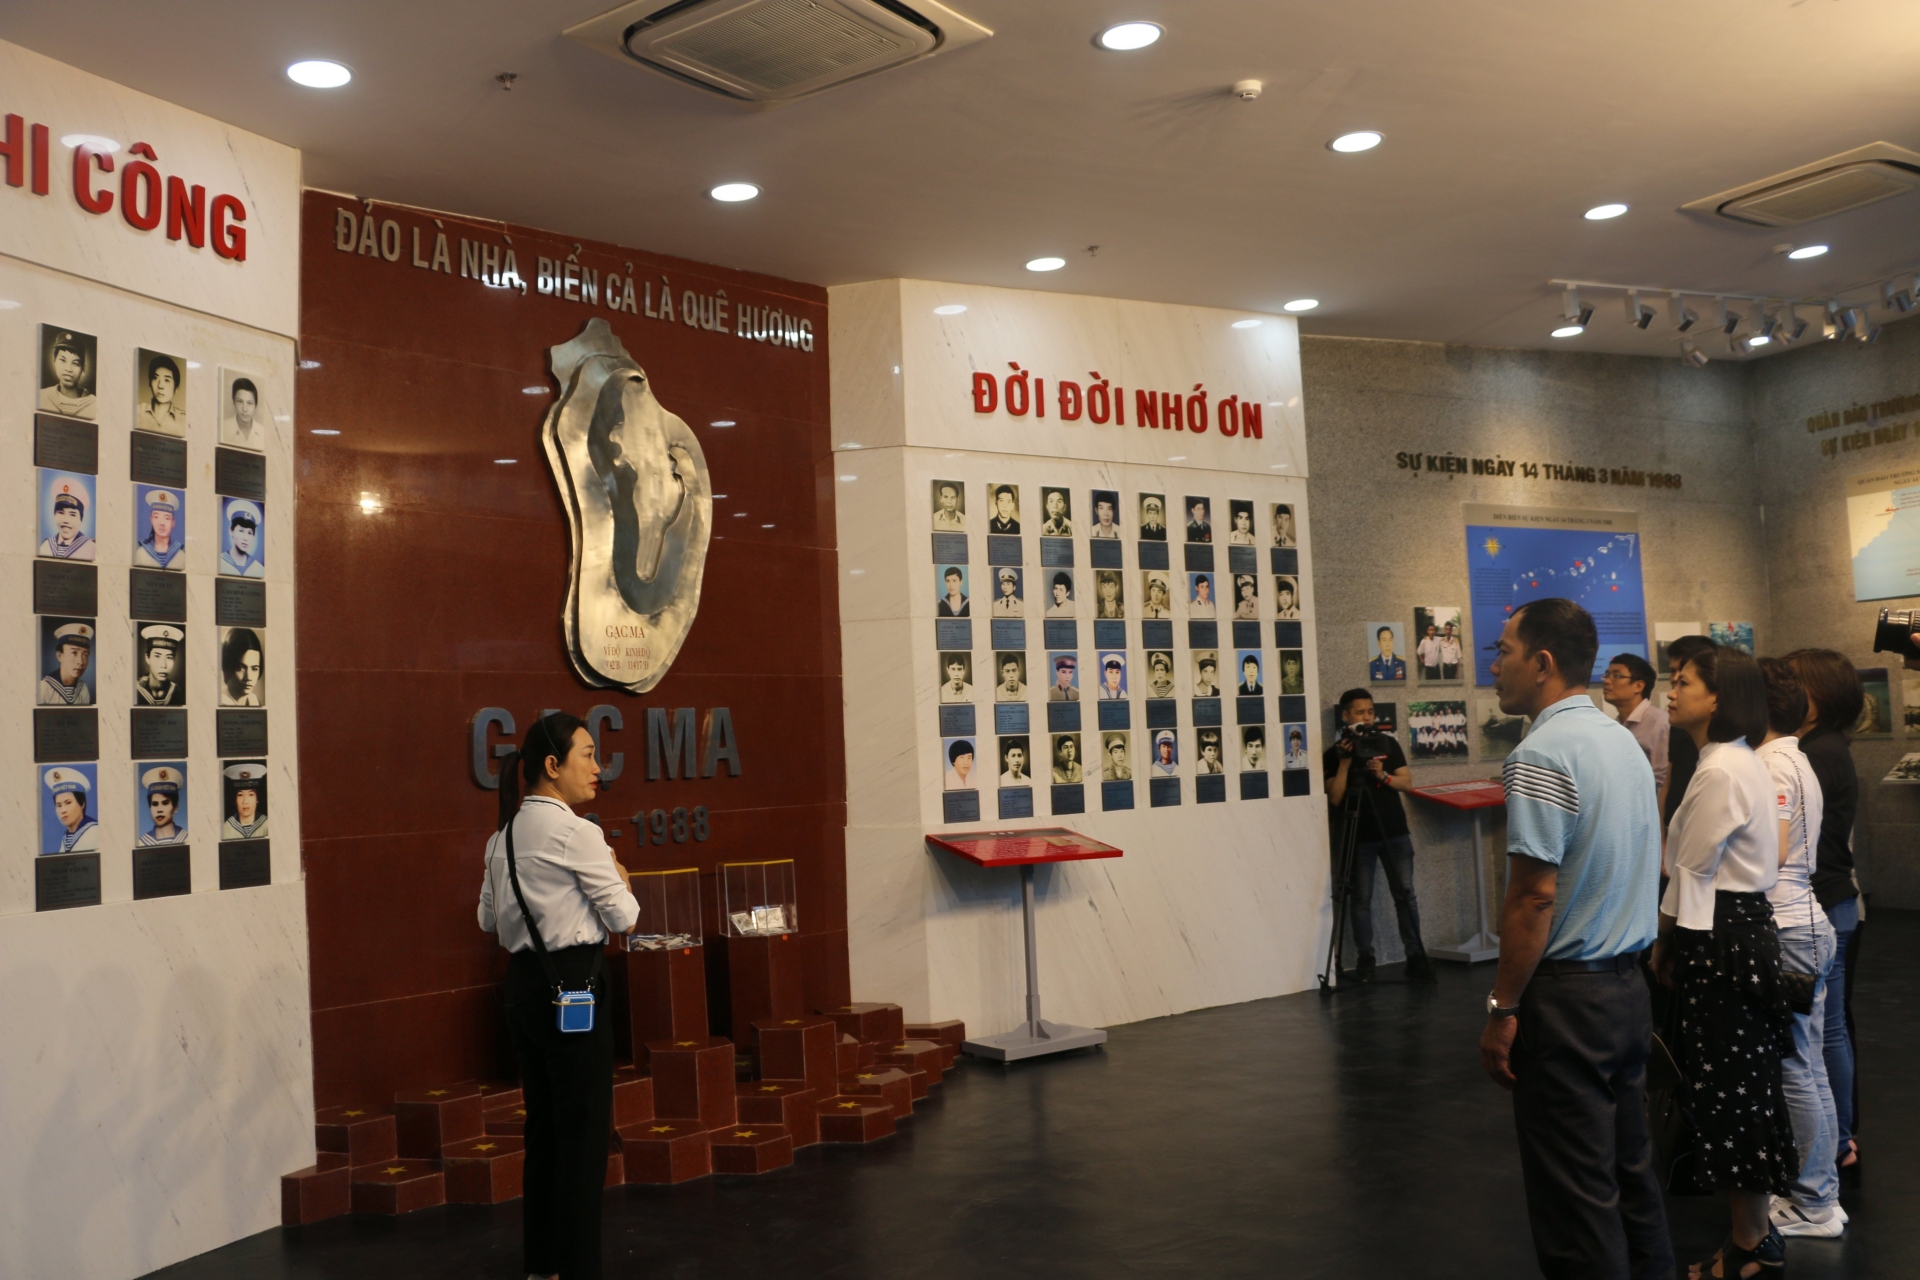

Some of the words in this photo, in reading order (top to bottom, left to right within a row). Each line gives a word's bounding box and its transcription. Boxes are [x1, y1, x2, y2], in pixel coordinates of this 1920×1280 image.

[73, 142, 246, 262] CÔNG
[336, 200, 400, 262] ĐẢO
[413, 219, 451, 274] LÀ
[460, 235, 527, 295] NHÀ,
[537, 243, 598, 306] BIỂN
[606, 262, 637, 314] CẢ
[645, 276, 675, 321] LÀ
[682, 289, 729, 333] QUÊ
[737, 303, 814, 352] HƯƠNG
[972, 361, 1045, 417] ĐỜI
[1058, 371, 1124, 425] ĐỜI
[1135, 383, 1208, 433] NHỚ
[1218, 394, 1263, 439] ƠN
[1395, 451, 1422, 478] SỰ
[1427, 450, 1468, 480] KIỆN
[1472, 454, 1515, 477] NGÀY
[1520, 462, 1539, 479] 14
[1542, 460, 1596, 483] THÁNG
[1598, 468, 1608, 484] 3
[1610, 465, 1645, 486] NĂM
[1646, 472, 1682, 489] 1988
[605, 625, 628, 639] GẠC
[630, 626, 645, 639] MA
[625, 647, 641, 657] KINH
[471, 704, 624, 790] GC
[645, 706, 742, 781] MA
[631, 805, 710, 847] 1988
